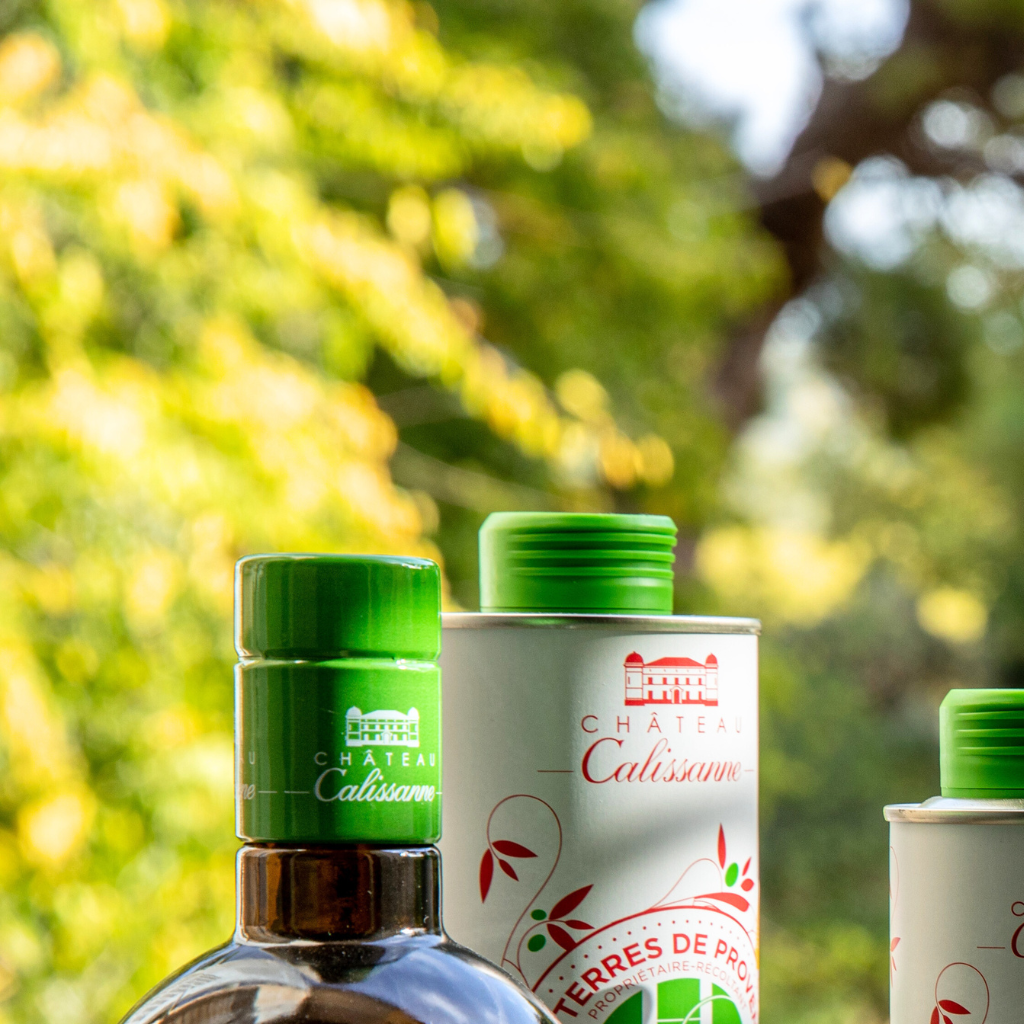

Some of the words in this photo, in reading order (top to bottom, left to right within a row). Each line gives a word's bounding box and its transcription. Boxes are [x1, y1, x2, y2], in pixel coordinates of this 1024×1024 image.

[581, 712, 742, 733] CHÂTEAU
[314, 750, 436, 767] CHÂTEAU
[581, 737, 742, 784] Calissanne
[314, 767, 435, 802] Calissanne
[553, 937, 663, 1019] TERRES
[672, 933, 709, 955] DE
